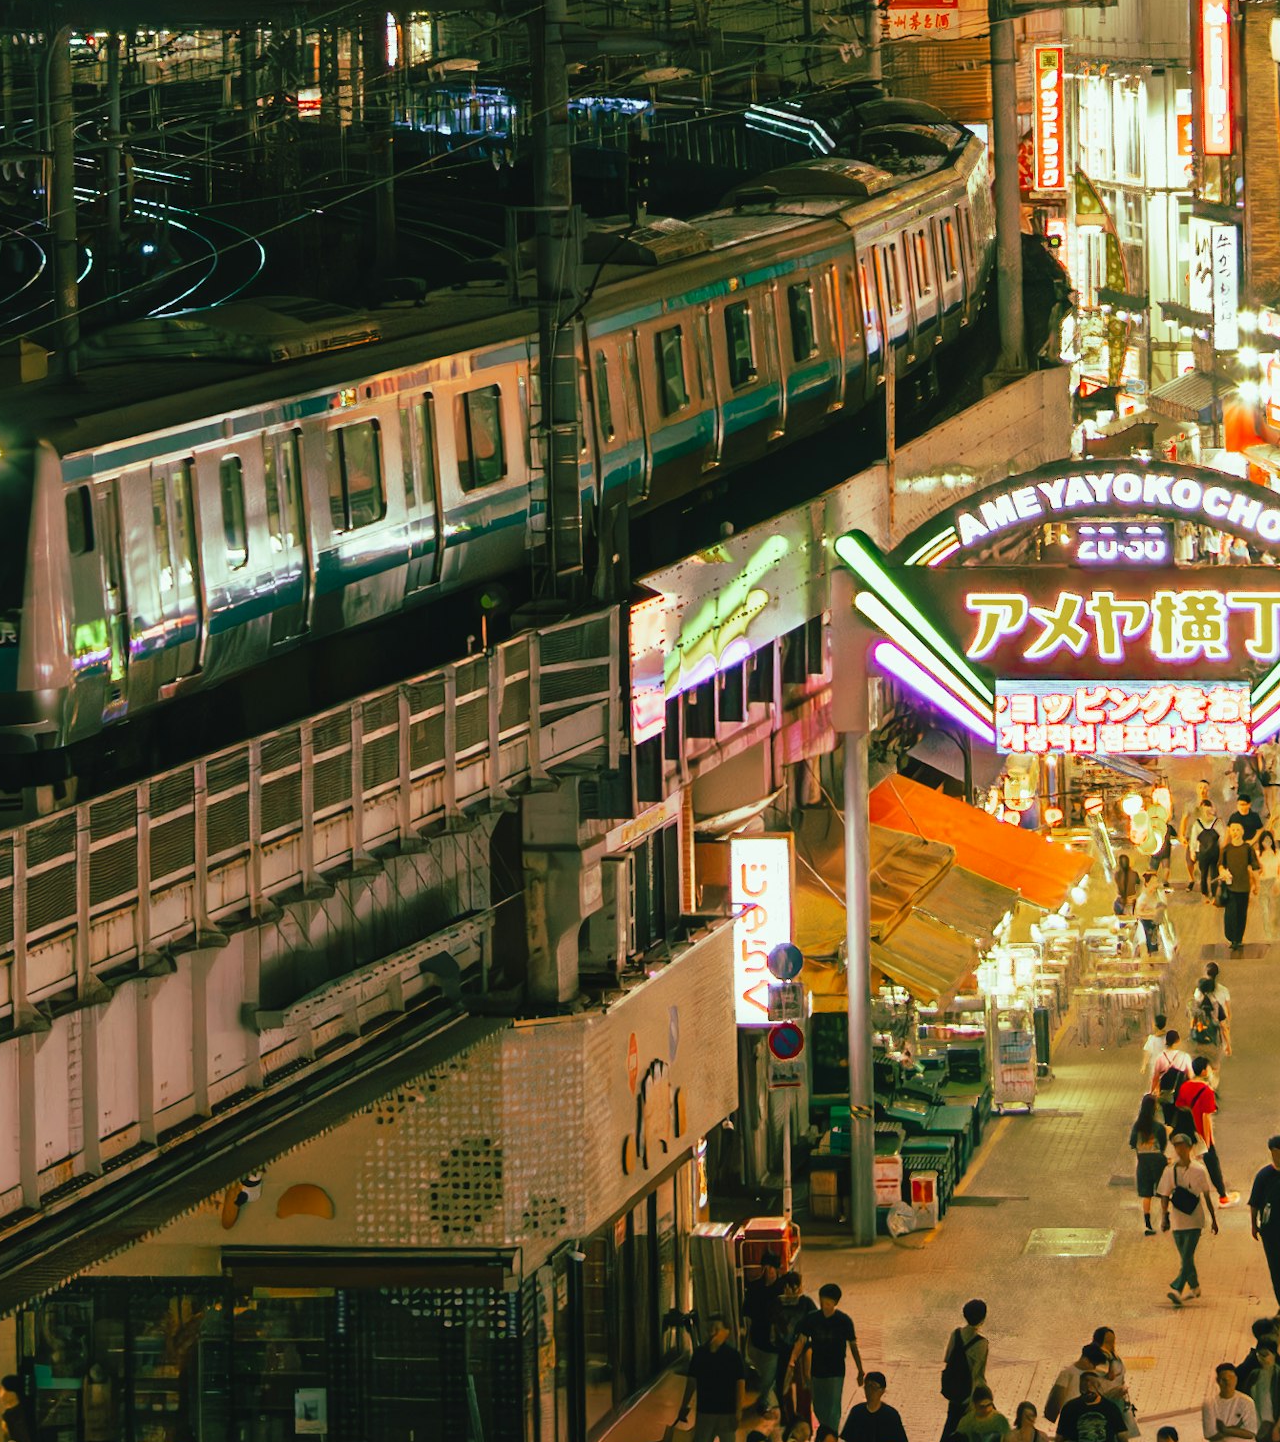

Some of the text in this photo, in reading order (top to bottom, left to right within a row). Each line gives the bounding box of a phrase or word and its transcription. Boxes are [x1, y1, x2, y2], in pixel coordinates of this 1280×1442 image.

[1041, 92, 1060, 187] サンドラッグ
[995, 684, 1251, 725] ョッピングをお
